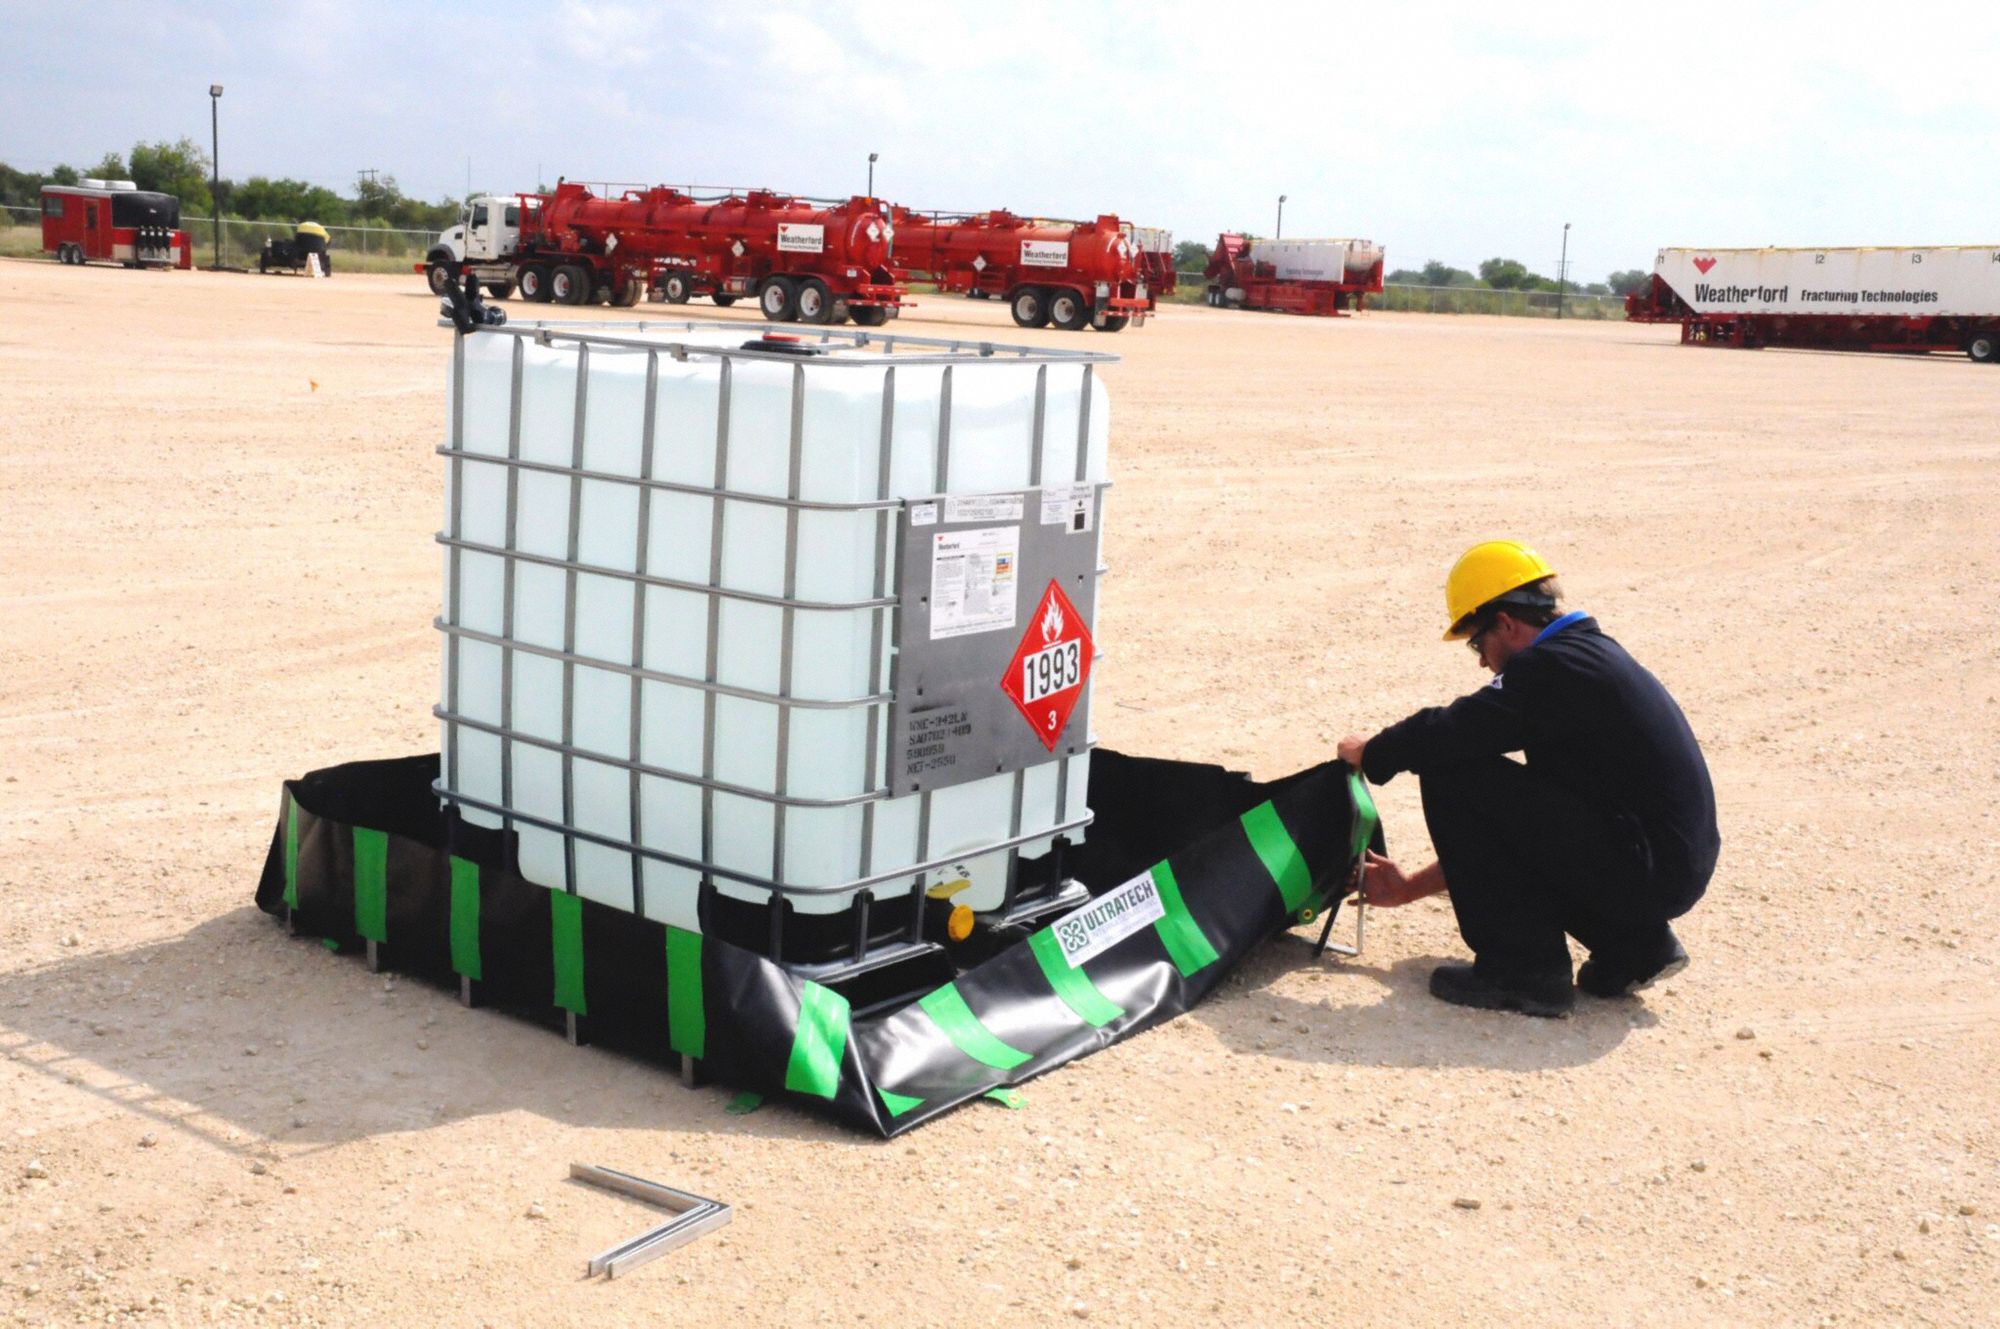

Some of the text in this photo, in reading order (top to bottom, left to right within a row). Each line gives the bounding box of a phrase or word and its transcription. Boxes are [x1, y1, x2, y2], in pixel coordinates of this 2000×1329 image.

[1694, 283, 1939, 304] Weatherford Fracturing Technologies
[1026, 642, 1079, 700] 1993
[1047, 709, 1058, 731] 3
[1082, 879, 1155, 932] ULTRATECH
